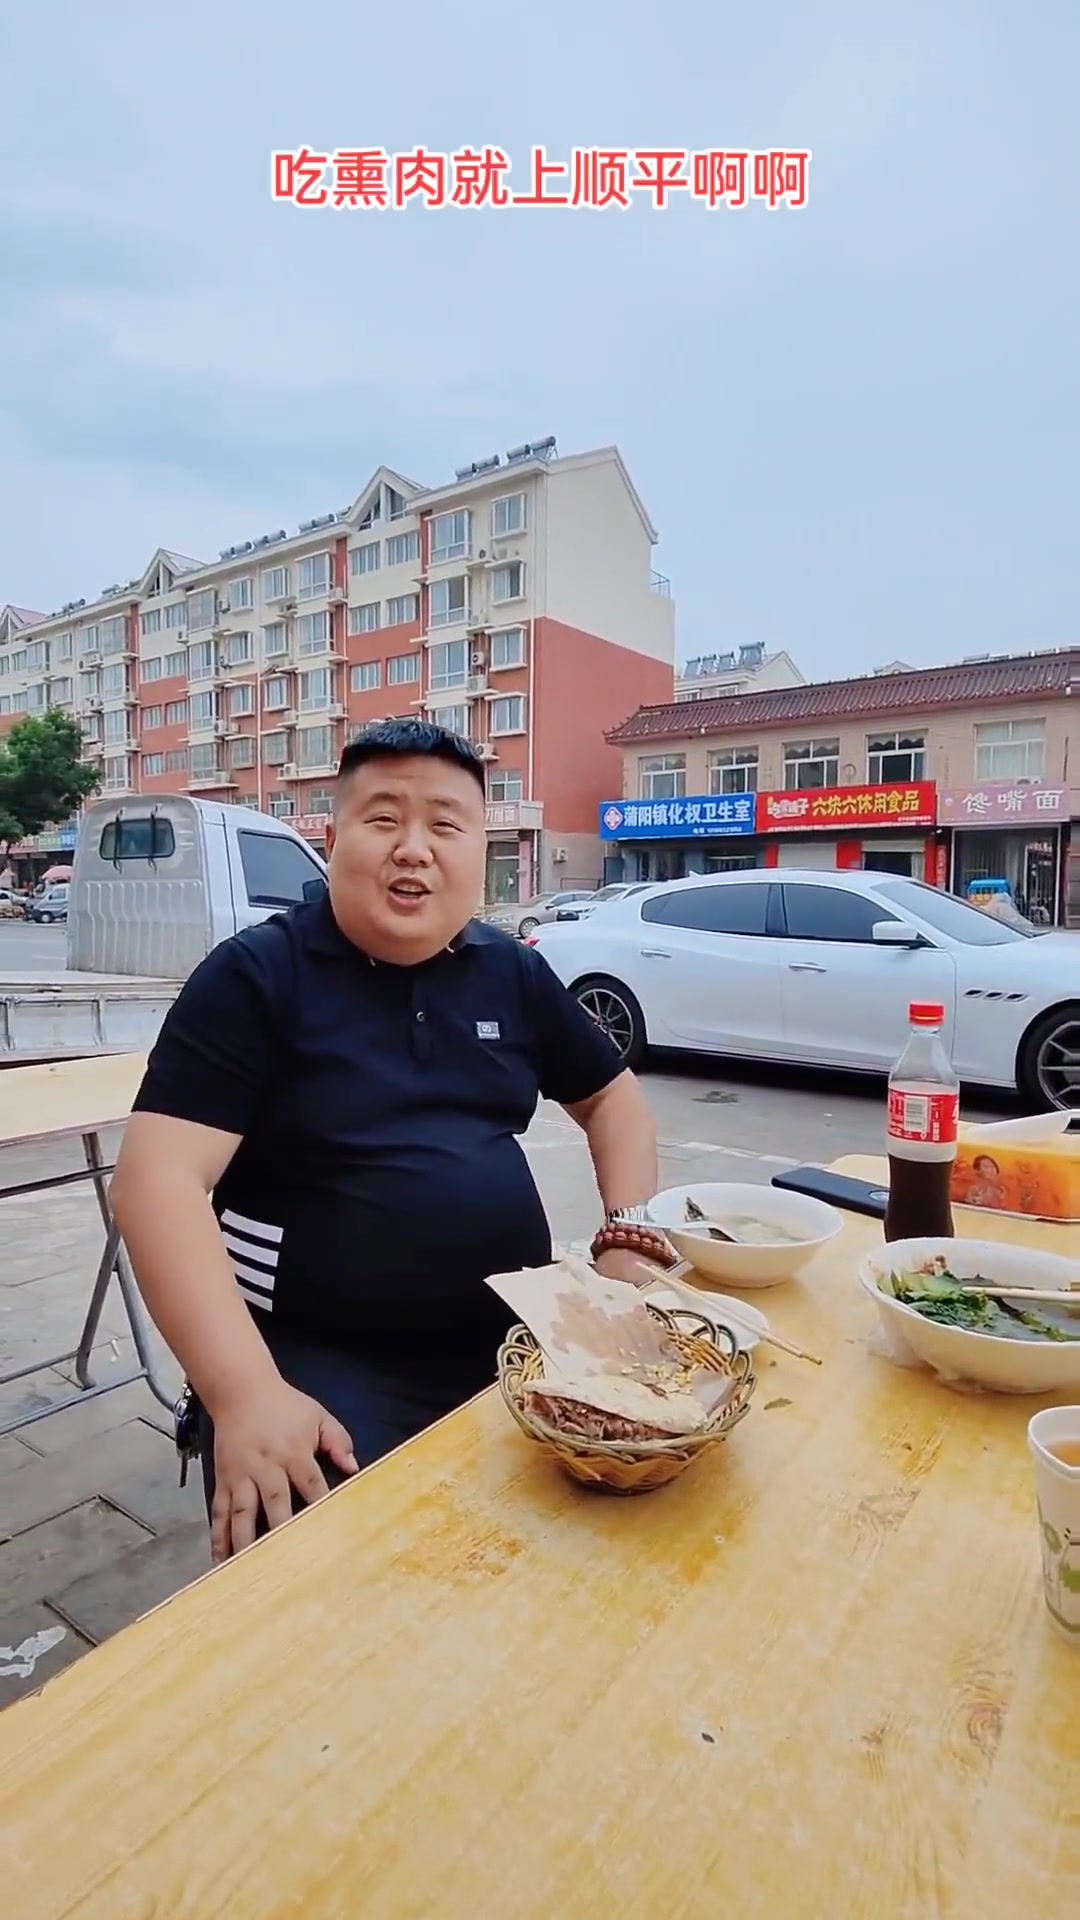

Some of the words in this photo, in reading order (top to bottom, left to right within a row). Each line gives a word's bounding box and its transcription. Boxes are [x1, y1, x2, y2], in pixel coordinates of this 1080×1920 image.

[623, 800, 751, 827] 蒲阳镇化权卫生室
[812, 790, 919, 816] 六块六休闲食品
[963, 789, 1064, 814] 馋嘴面
